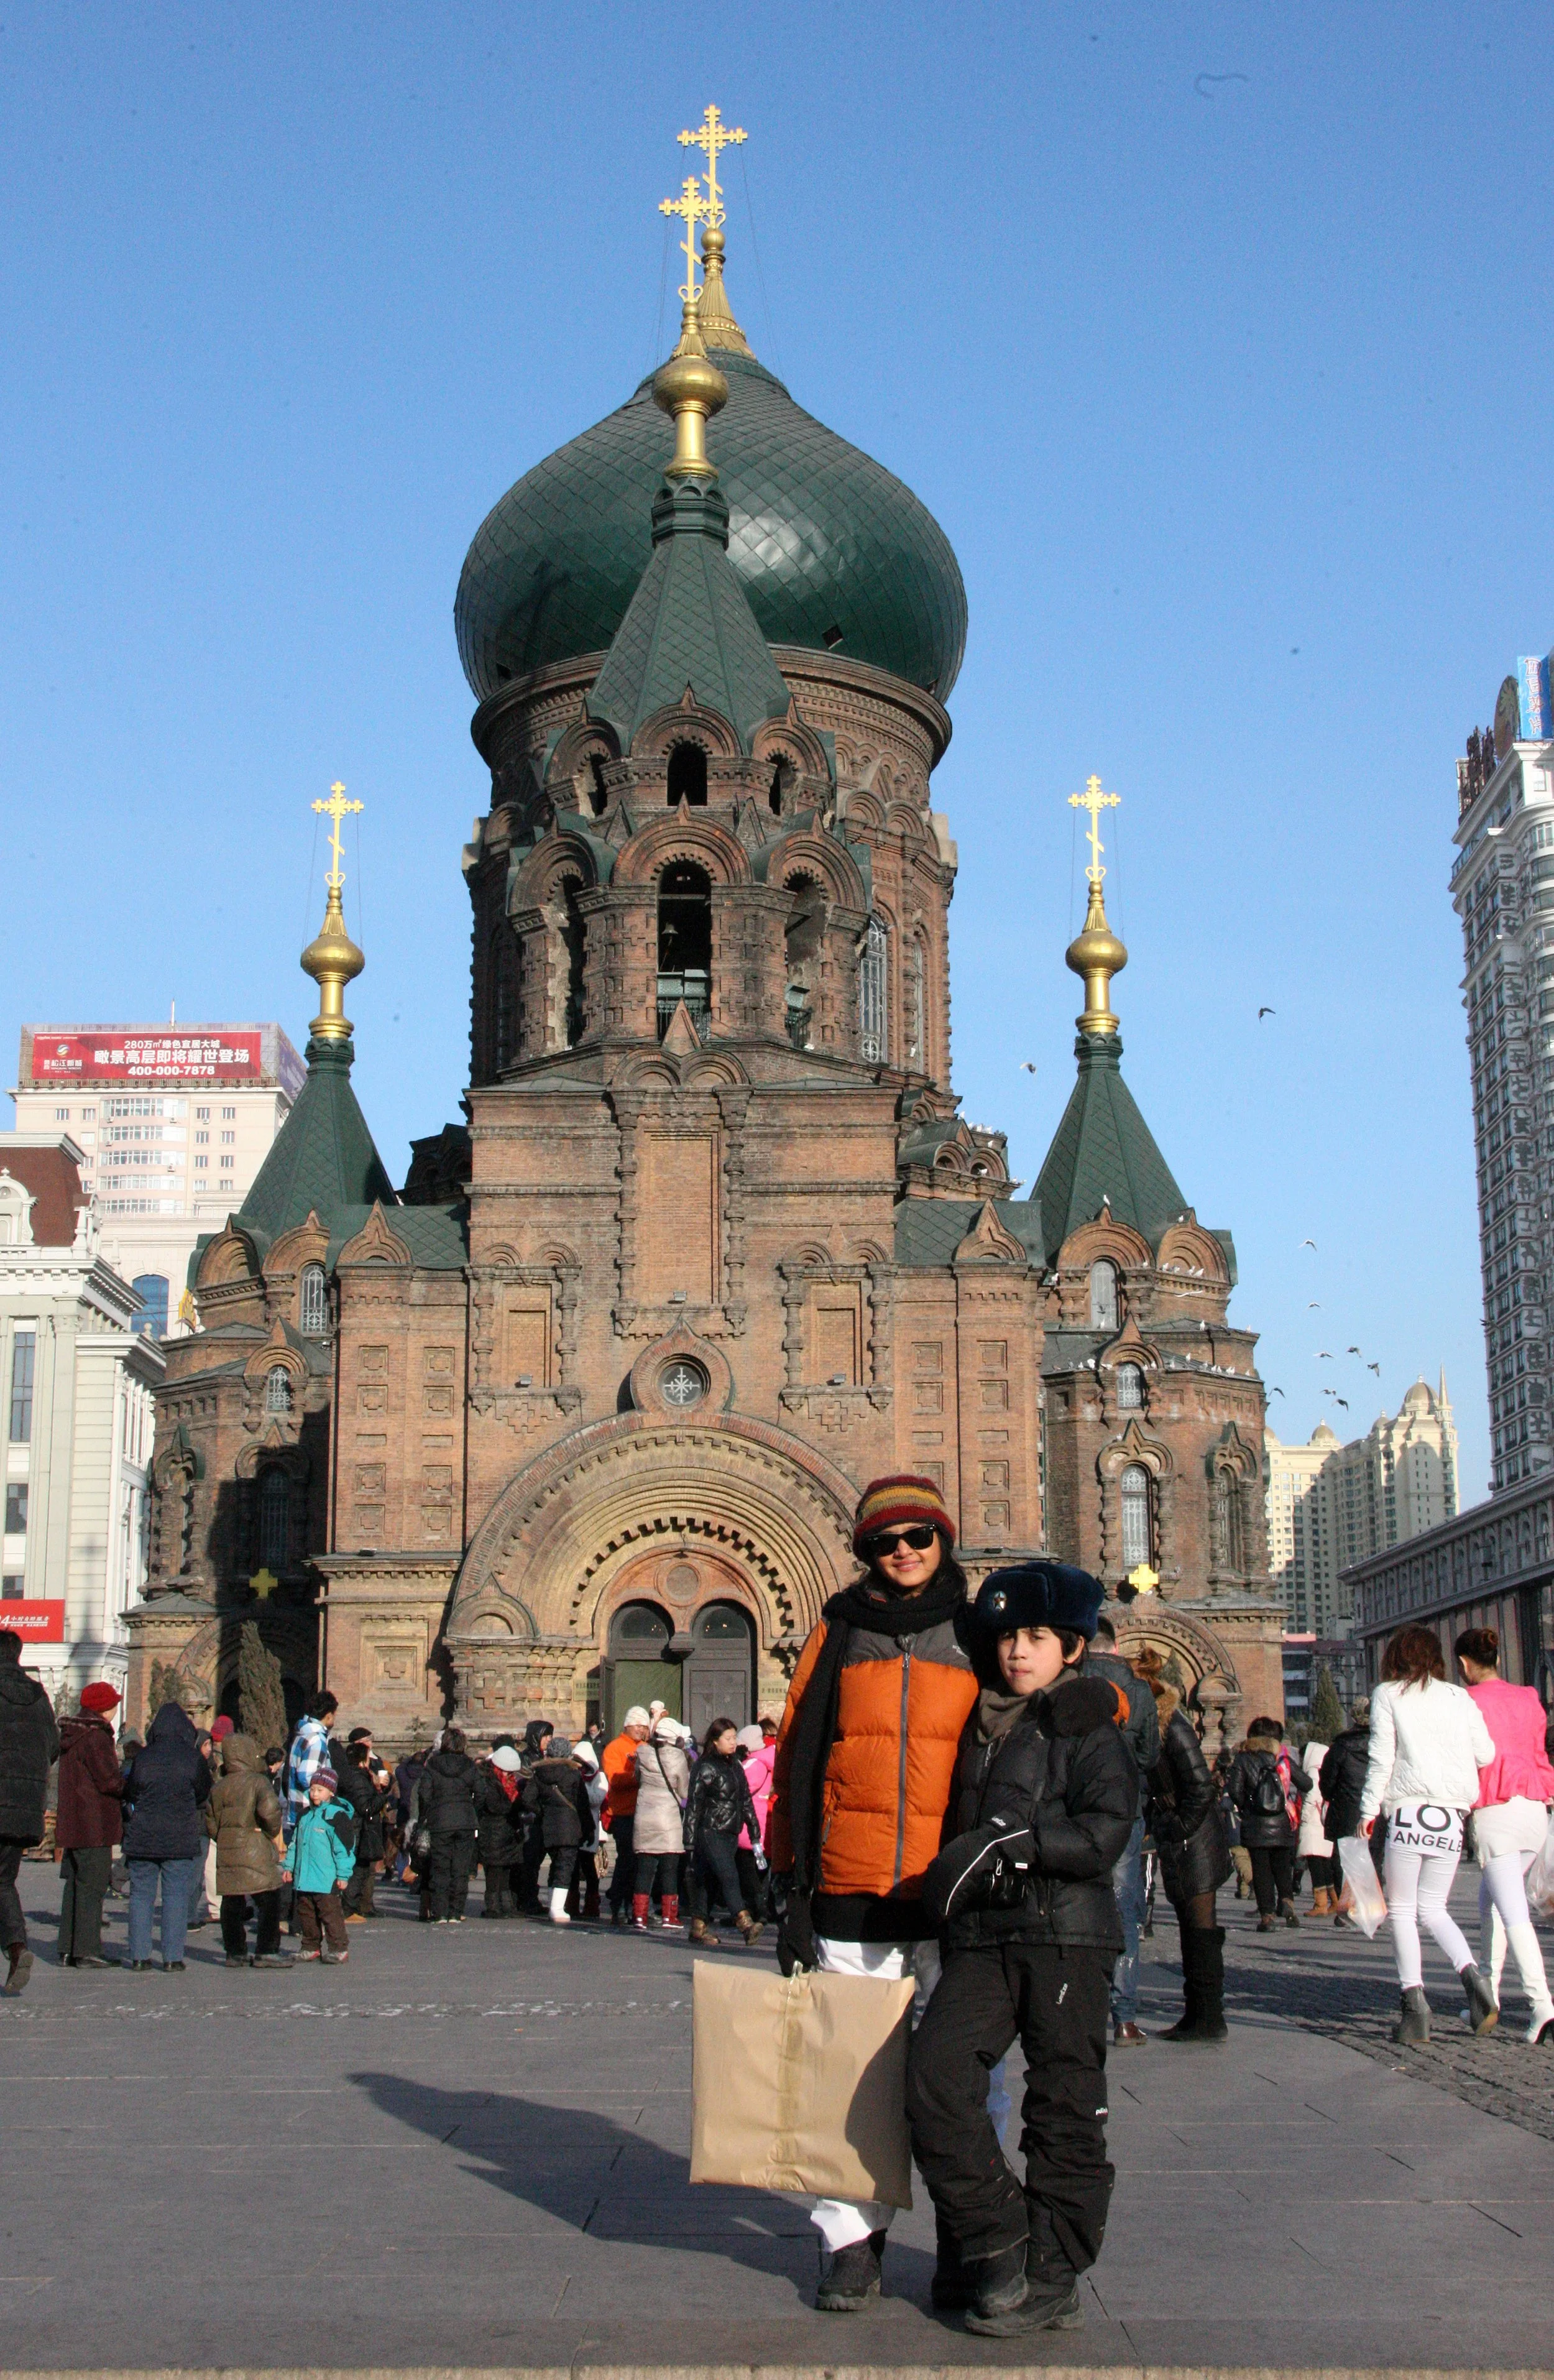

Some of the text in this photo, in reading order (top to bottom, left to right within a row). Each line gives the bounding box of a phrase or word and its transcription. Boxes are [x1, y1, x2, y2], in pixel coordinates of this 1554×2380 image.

[94, 1049, 250, 1064] 瞰景高层即将耀世登场
[127, 1066, 215, 1075] 400-000-7878
